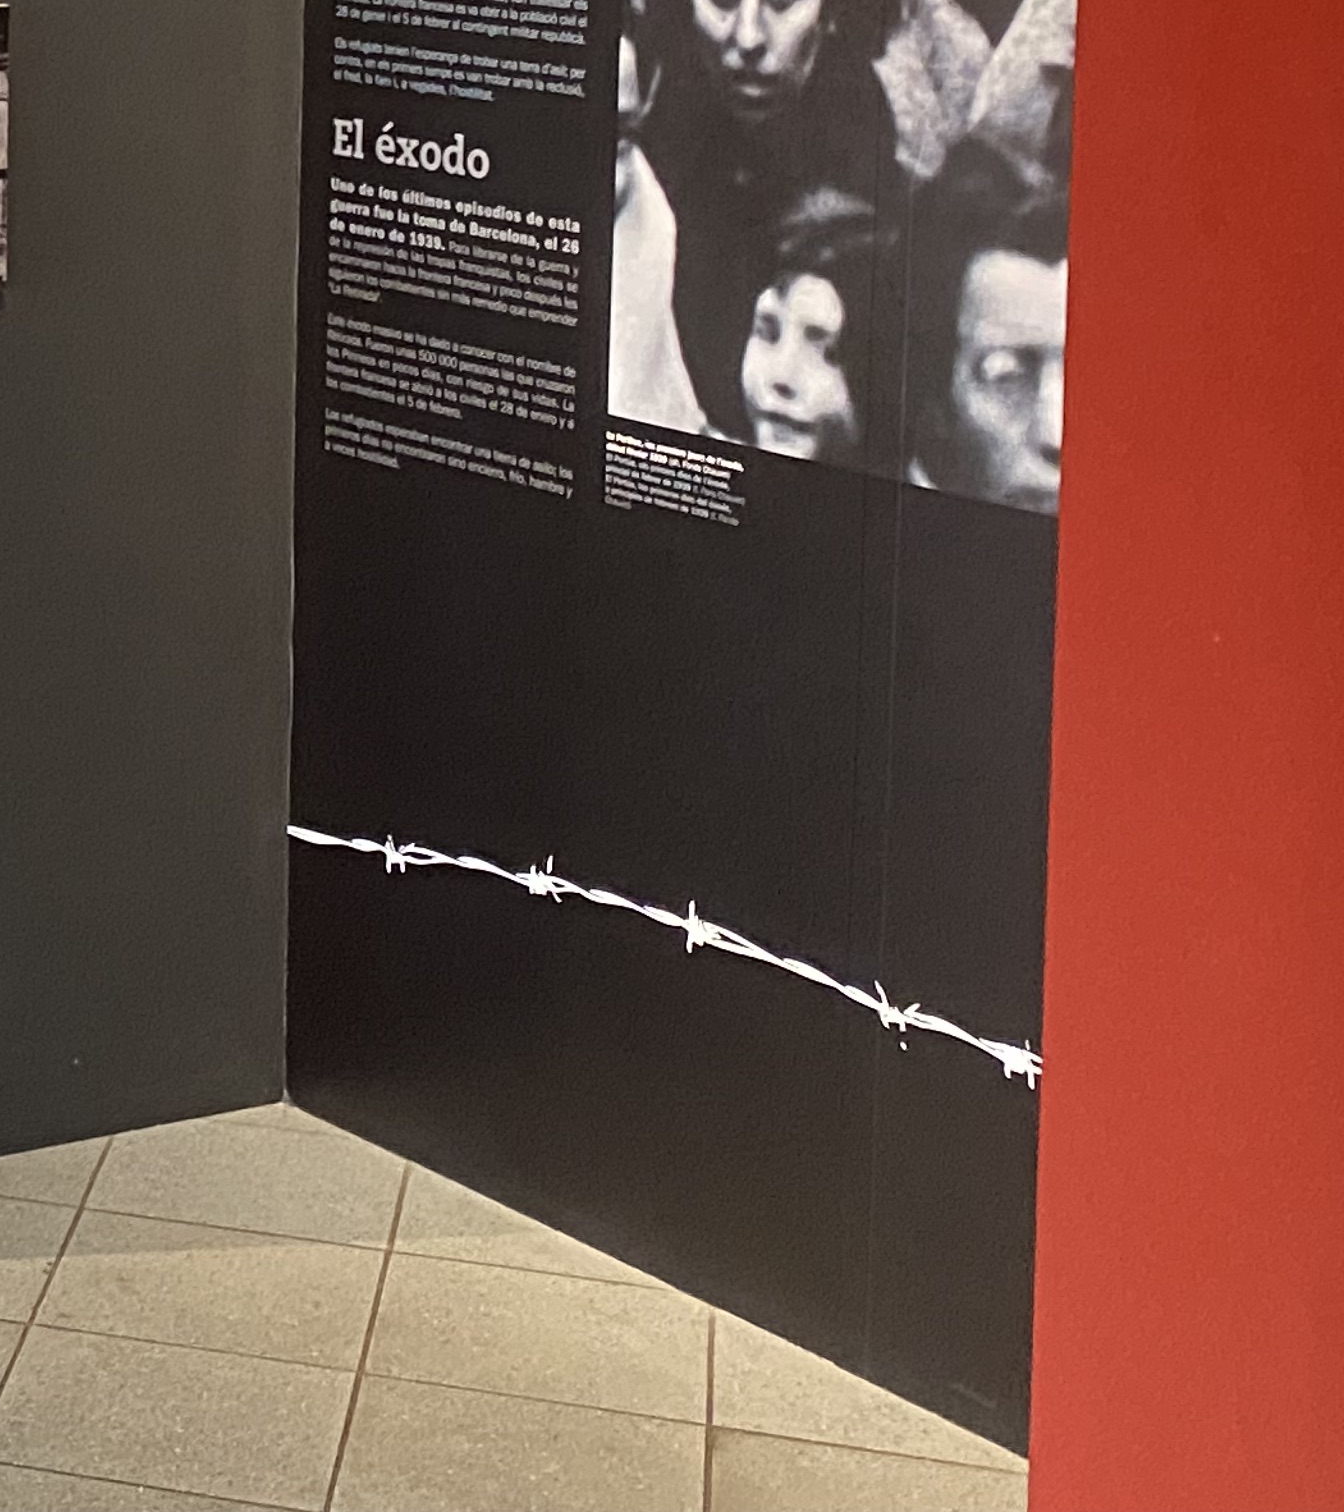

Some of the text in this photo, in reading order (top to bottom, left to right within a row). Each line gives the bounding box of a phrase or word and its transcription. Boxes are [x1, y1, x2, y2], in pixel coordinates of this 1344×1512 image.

[332, 117, 491, 179] El éxodo
[358, 183, 374, 196] de
[378, 186, 398, 201] los
[454, 201, 522, 222] episodios
[525, 211, 544, 227] de
[548, 217, 580, 233] esta
